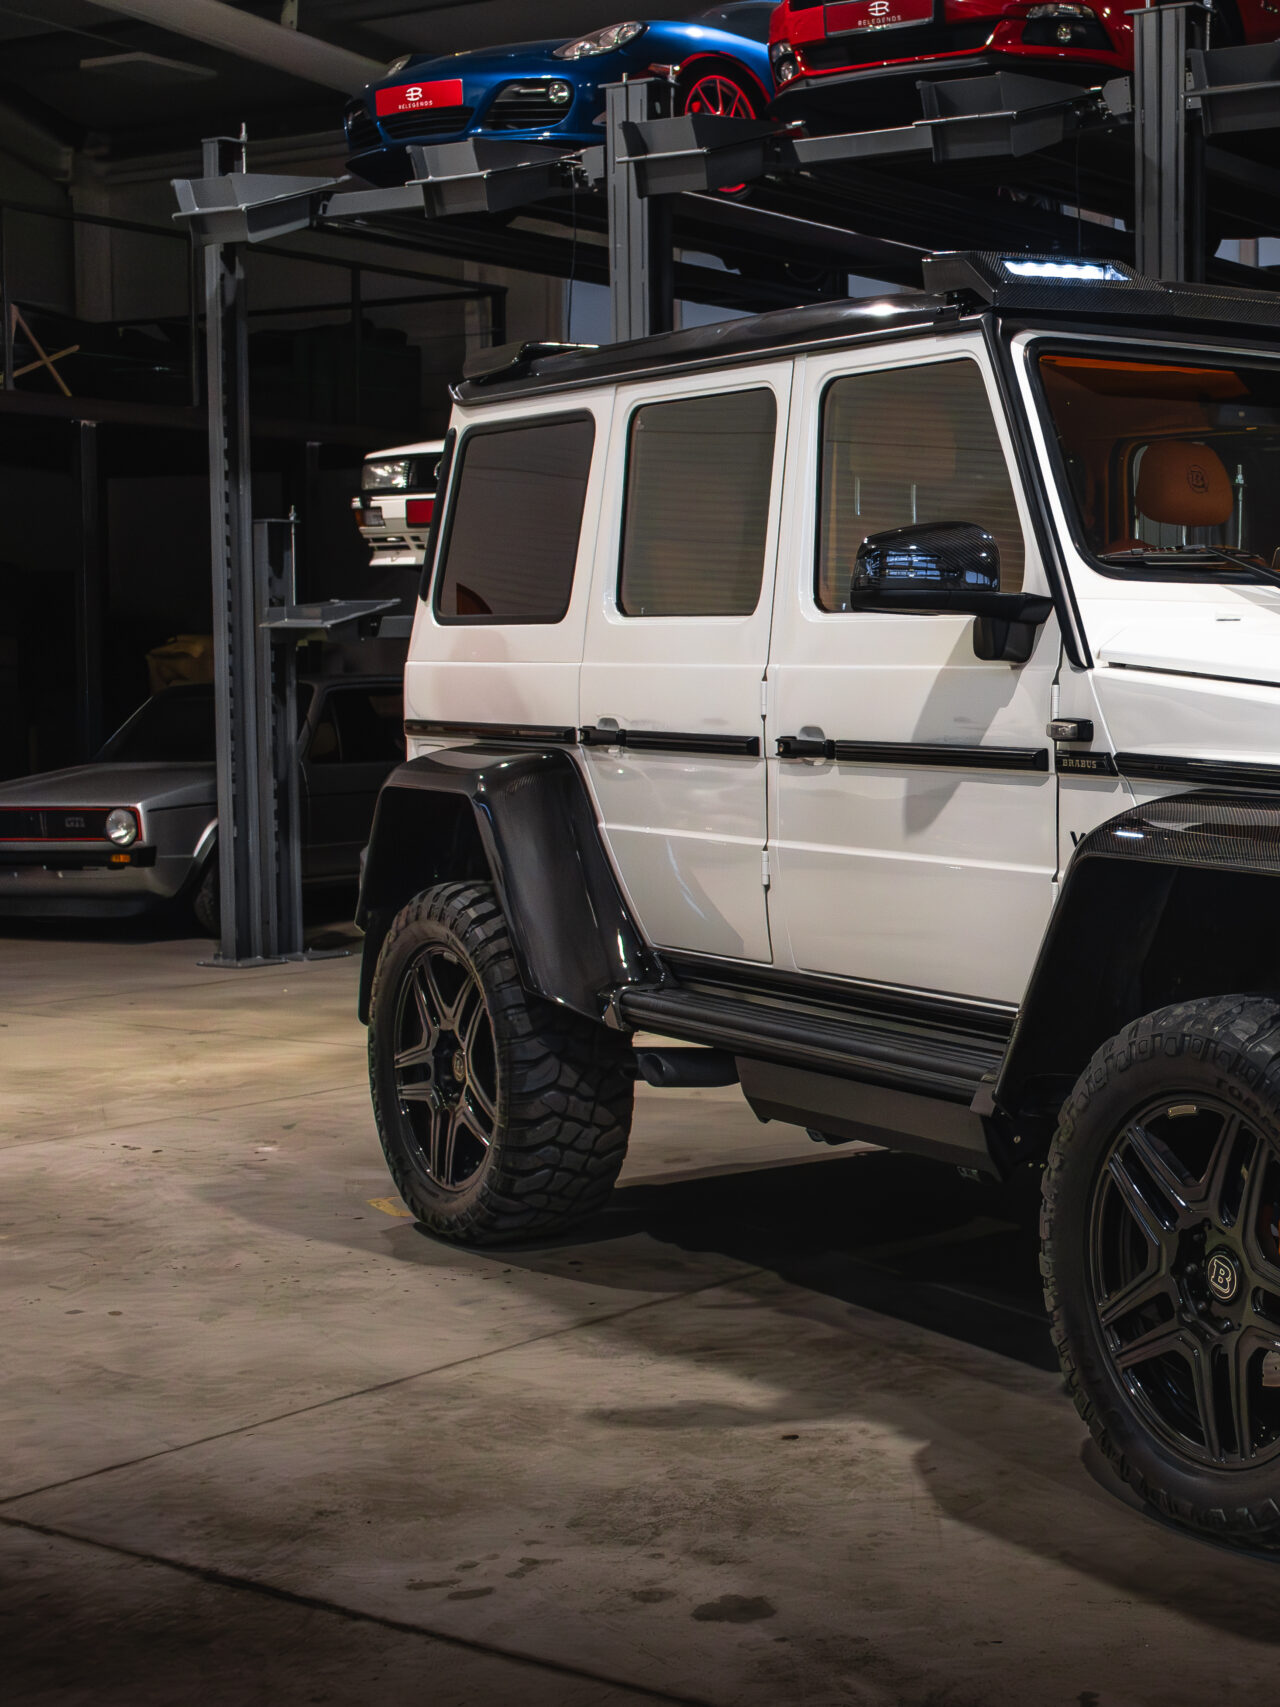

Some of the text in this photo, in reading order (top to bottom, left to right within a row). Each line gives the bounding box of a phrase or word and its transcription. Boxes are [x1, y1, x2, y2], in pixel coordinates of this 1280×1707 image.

[858, 15, 902, 26] RELEGENDS
[1062, 758, 1097, 769] BRABUS
[1210, 1258, 1231, 1294] B
